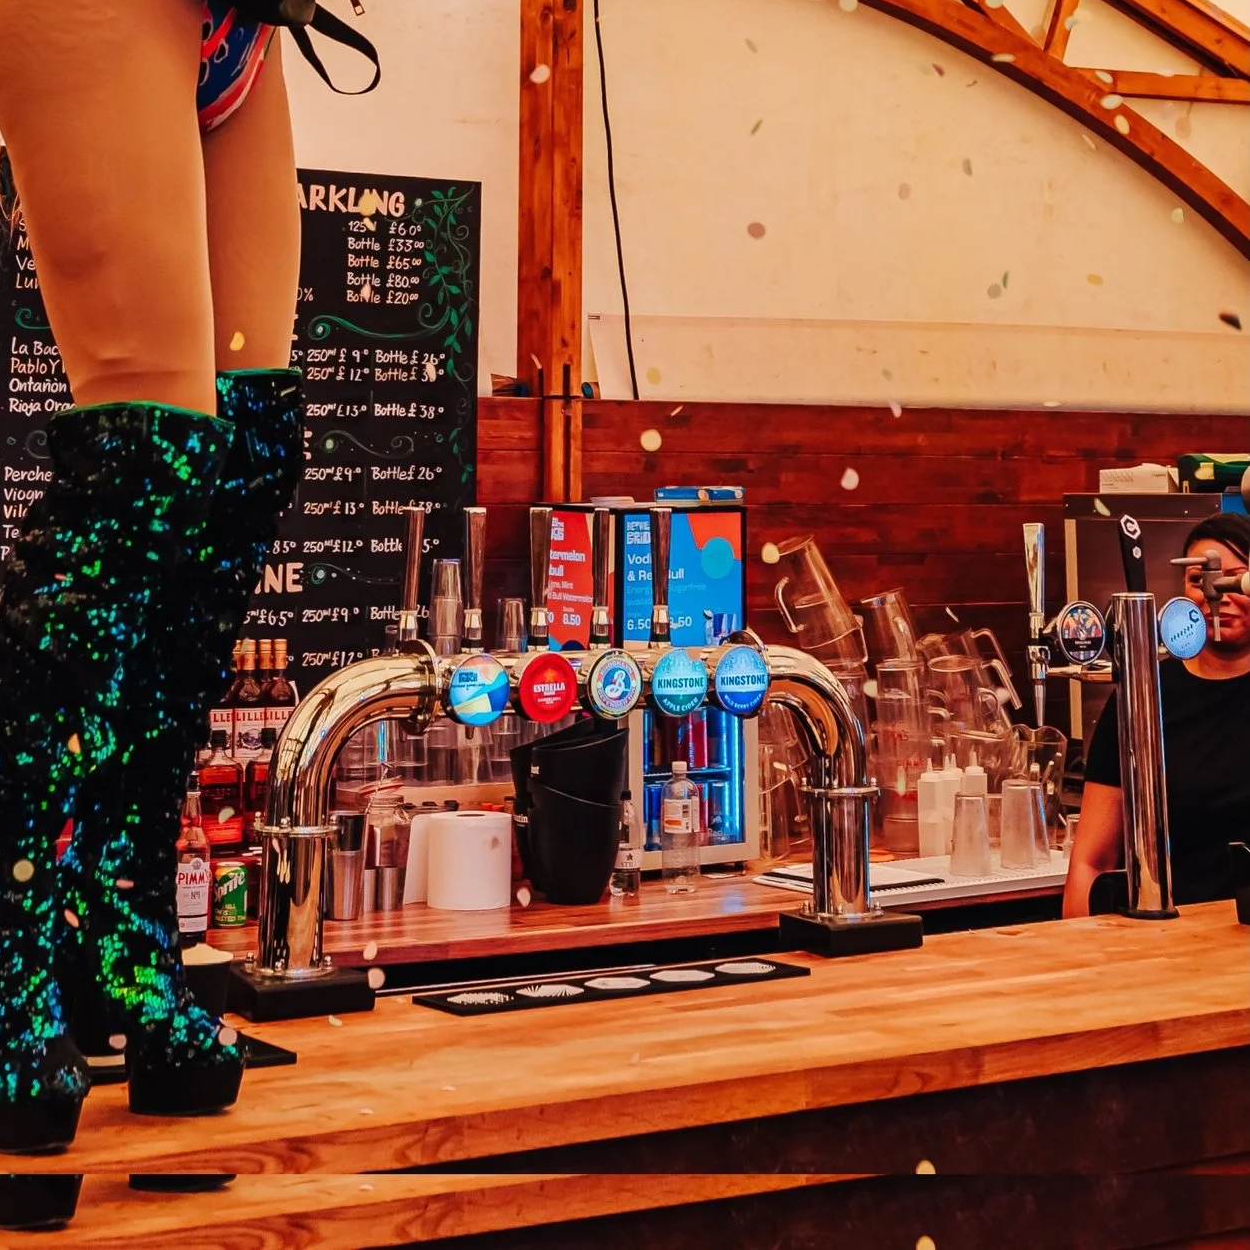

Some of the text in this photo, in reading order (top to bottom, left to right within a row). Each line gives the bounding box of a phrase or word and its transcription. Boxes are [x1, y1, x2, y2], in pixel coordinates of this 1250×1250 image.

[348, 237, 380, 250] Bottle
[348, 254, 379, 267] Bottle
[347, 272, 380, 287] Bottle
[12, 337, 28, 354] La
[375, 350, 408, 364] Bottle
[11, 357, 47, 374] Pablo
[375, 368, 408, 381] Bottle
[9, 398, 41, 416] Rioja
[374, 404, 406, 416] Bottle
[5, 466, 52, 481] Perche
[371, 467, 407, 480] Bottle
[372, 501, 404, 515] Bottle
[627, 570, 636, 582] &
[638, 570, 652, 581] Re
[656, 676, 705, 689] KINGSTONE
[720, 674, 767, 687] KINGSTONE
[533, 682, 566, 693] ESTRELLA
[662, 696, 699, 712] APPLE CIDER
